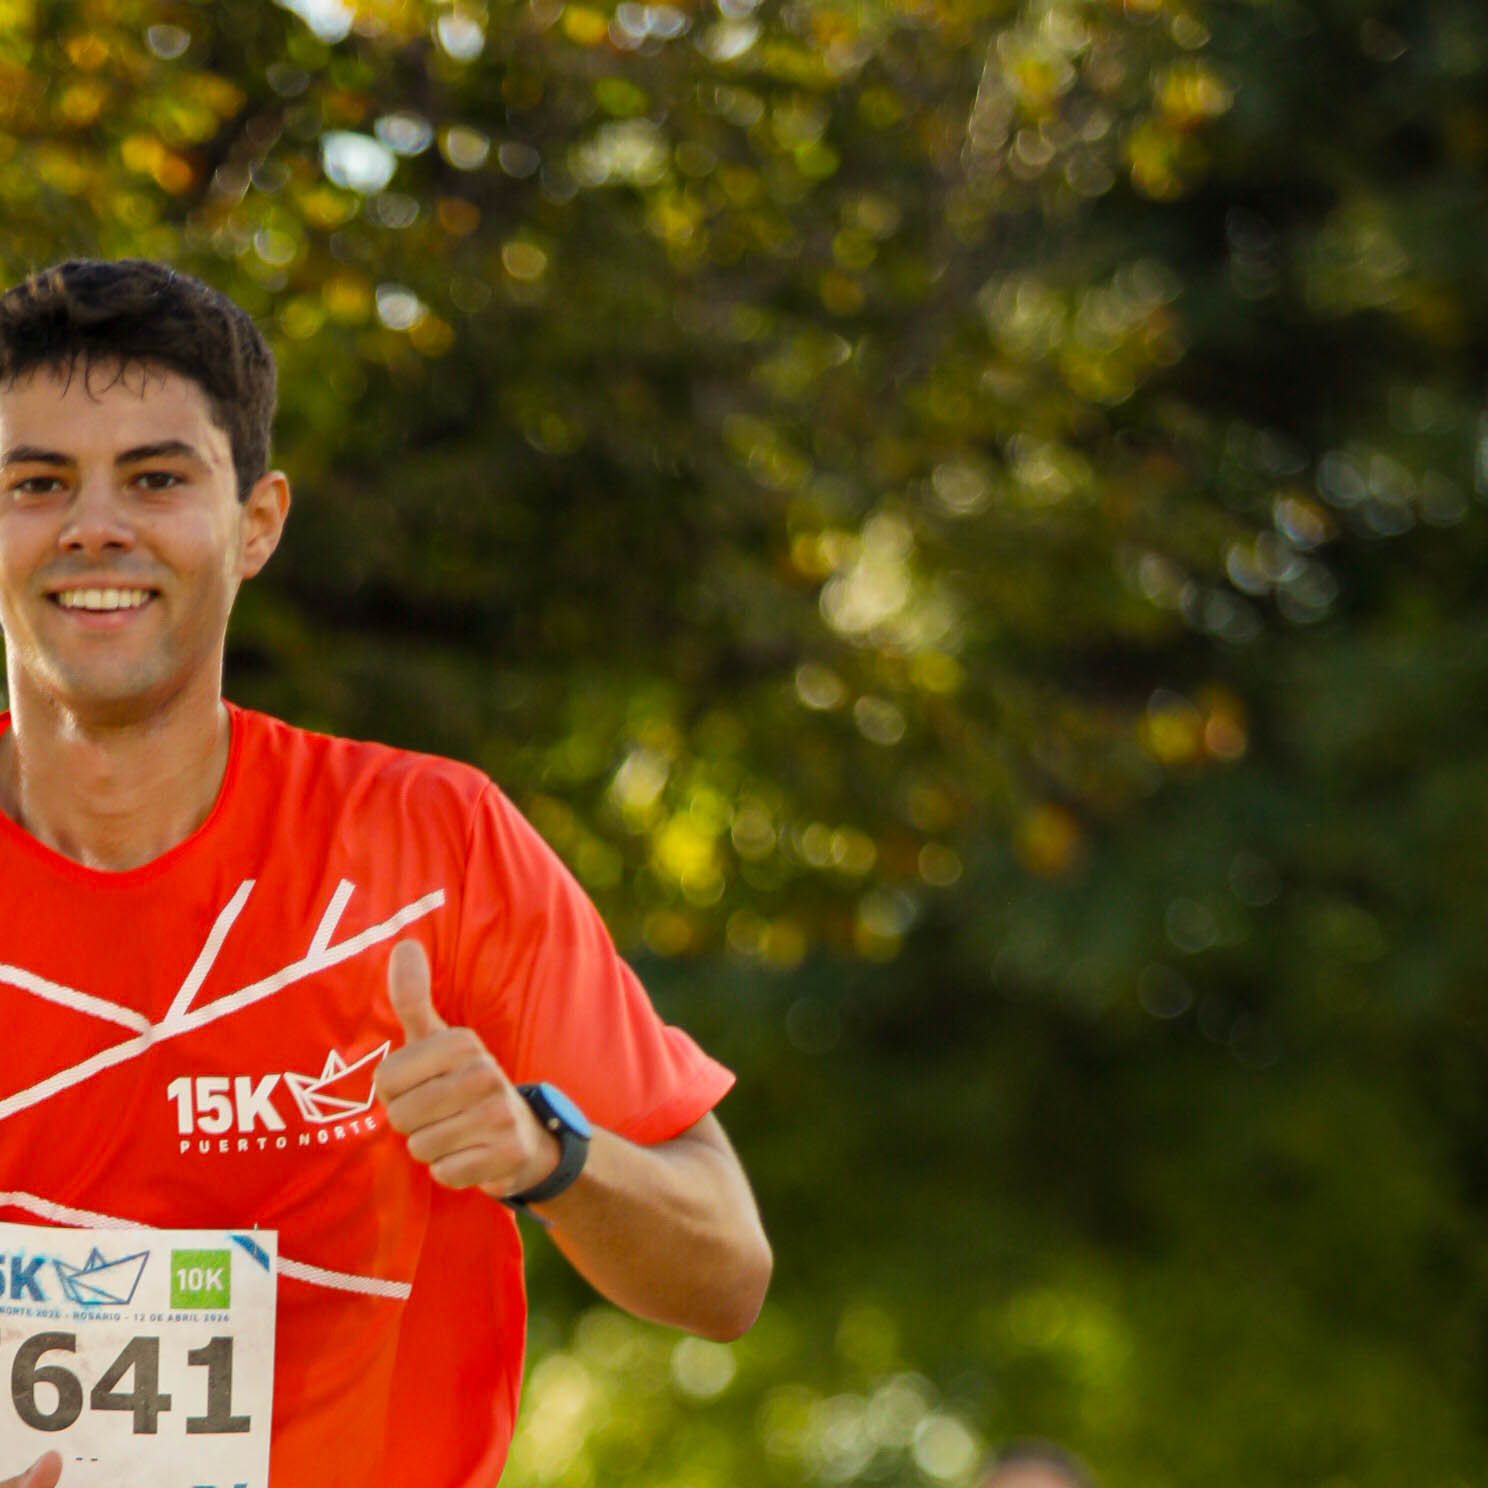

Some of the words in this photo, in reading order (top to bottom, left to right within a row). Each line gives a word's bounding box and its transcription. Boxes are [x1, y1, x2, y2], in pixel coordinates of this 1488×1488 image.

[167, 1073, 287, 1135] 15K
[179, 1136, 288, 1154] PUERTO
[298, 1115, 377, 1147] NORTE
[176, 1267, 224, 1292] 10K
[72, 1311, 121, 1321] ROSARIO
[134, 1313, 145, 1322] 12
[149, 1313, 164, 1322] DE
[168, 1313, 199, 1322] ABRIL
